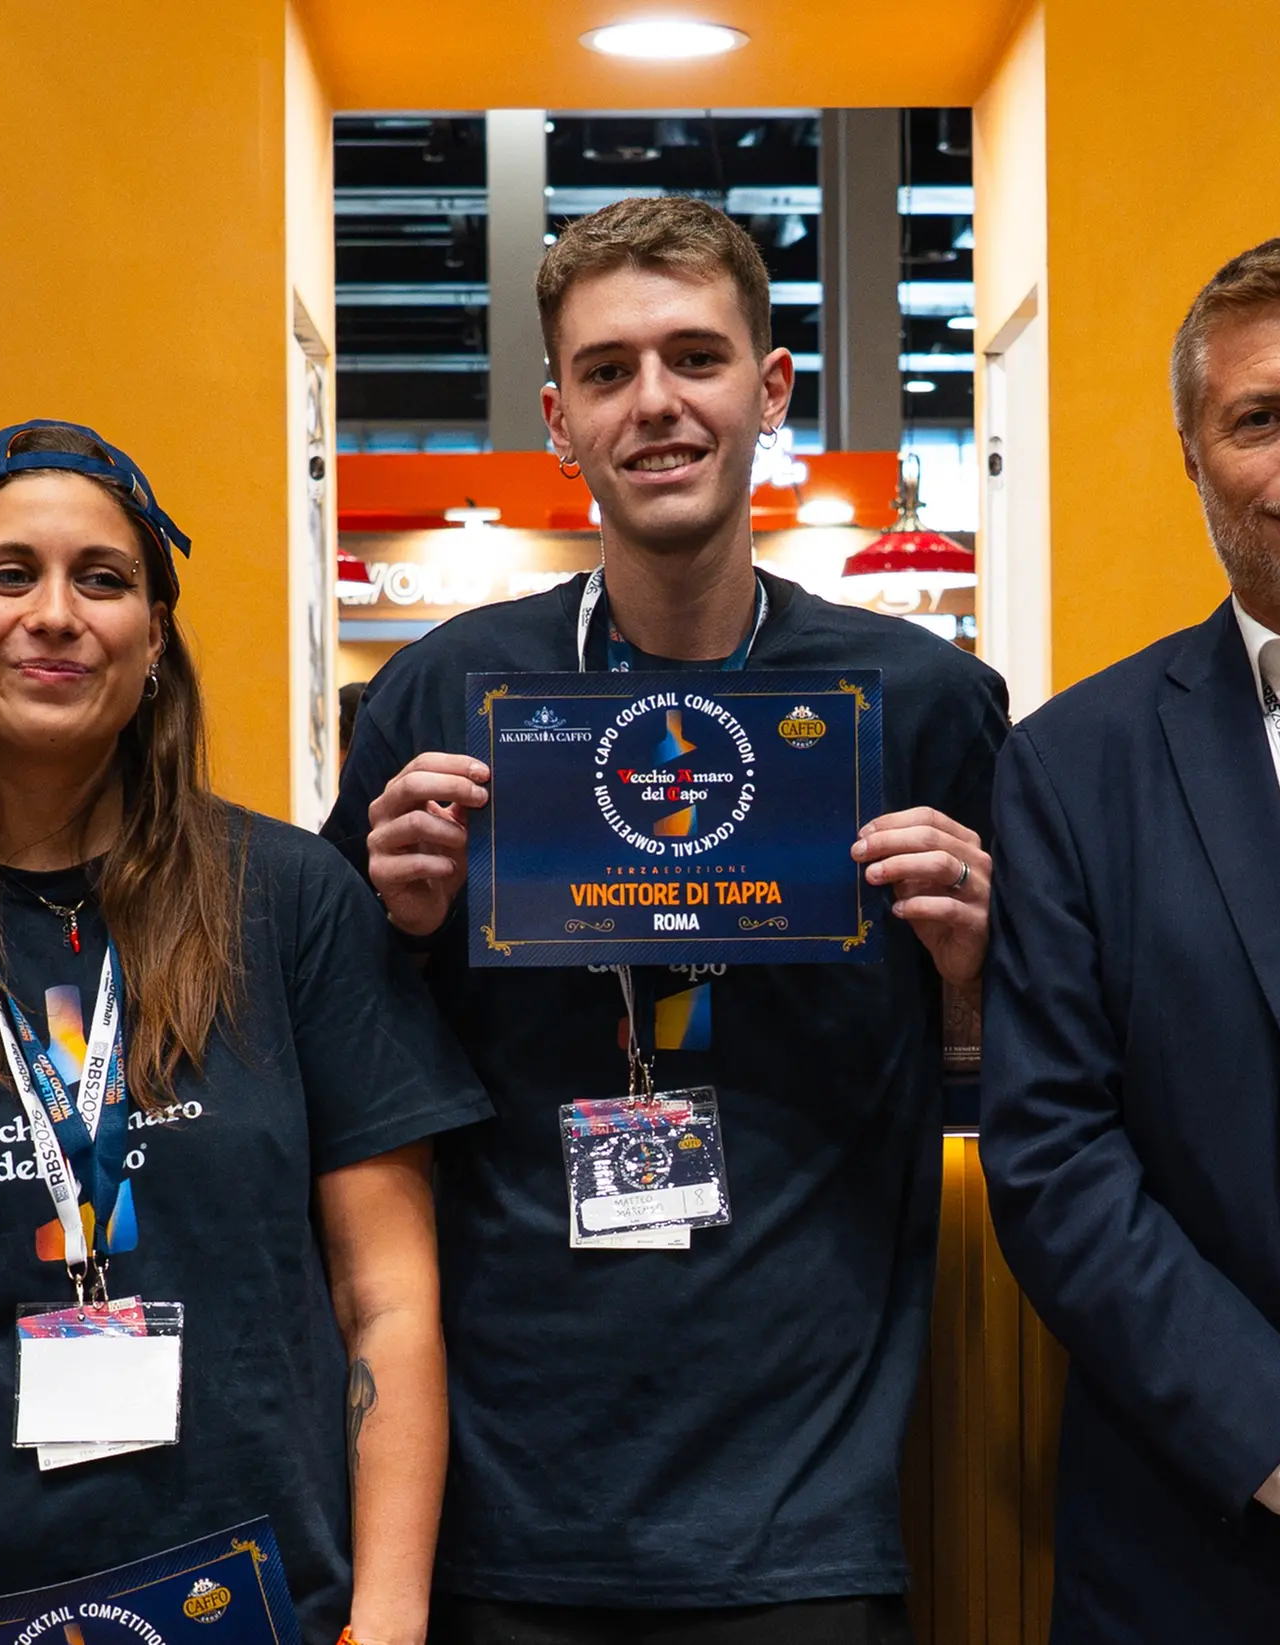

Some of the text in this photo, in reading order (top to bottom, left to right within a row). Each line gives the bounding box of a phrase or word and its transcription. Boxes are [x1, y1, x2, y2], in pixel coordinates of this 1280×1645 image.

[499, 730, 592, 743] AKADEMIA CAFFO
[595, 692, 756, 765] CAPO COCKTAIL COMPETITION
[780, 721, 824, 736] CAFFO
[616, 769, 733, 784] Vecchio Amaro
[641, 787, 707, 804] del Capo
[594, 784, 756, 858] CAPO COCKTAIL COMPETITION
[570, 880, 783, 907] VINCITORE DI TAPPA
[653, 913, 701, 931] ROMA
[102, 976, 117, 1027] otsman
[32, 1063, 64, 1123] COMPETITION
[37, 1053, 74, 1120] CAPO COCKTAIL
[32, 1109, 65, 1187] RBS2026
[186, 1589, 229, 1616] CAFFO
[79, 1603, 168, 1645] COMPETITIO
